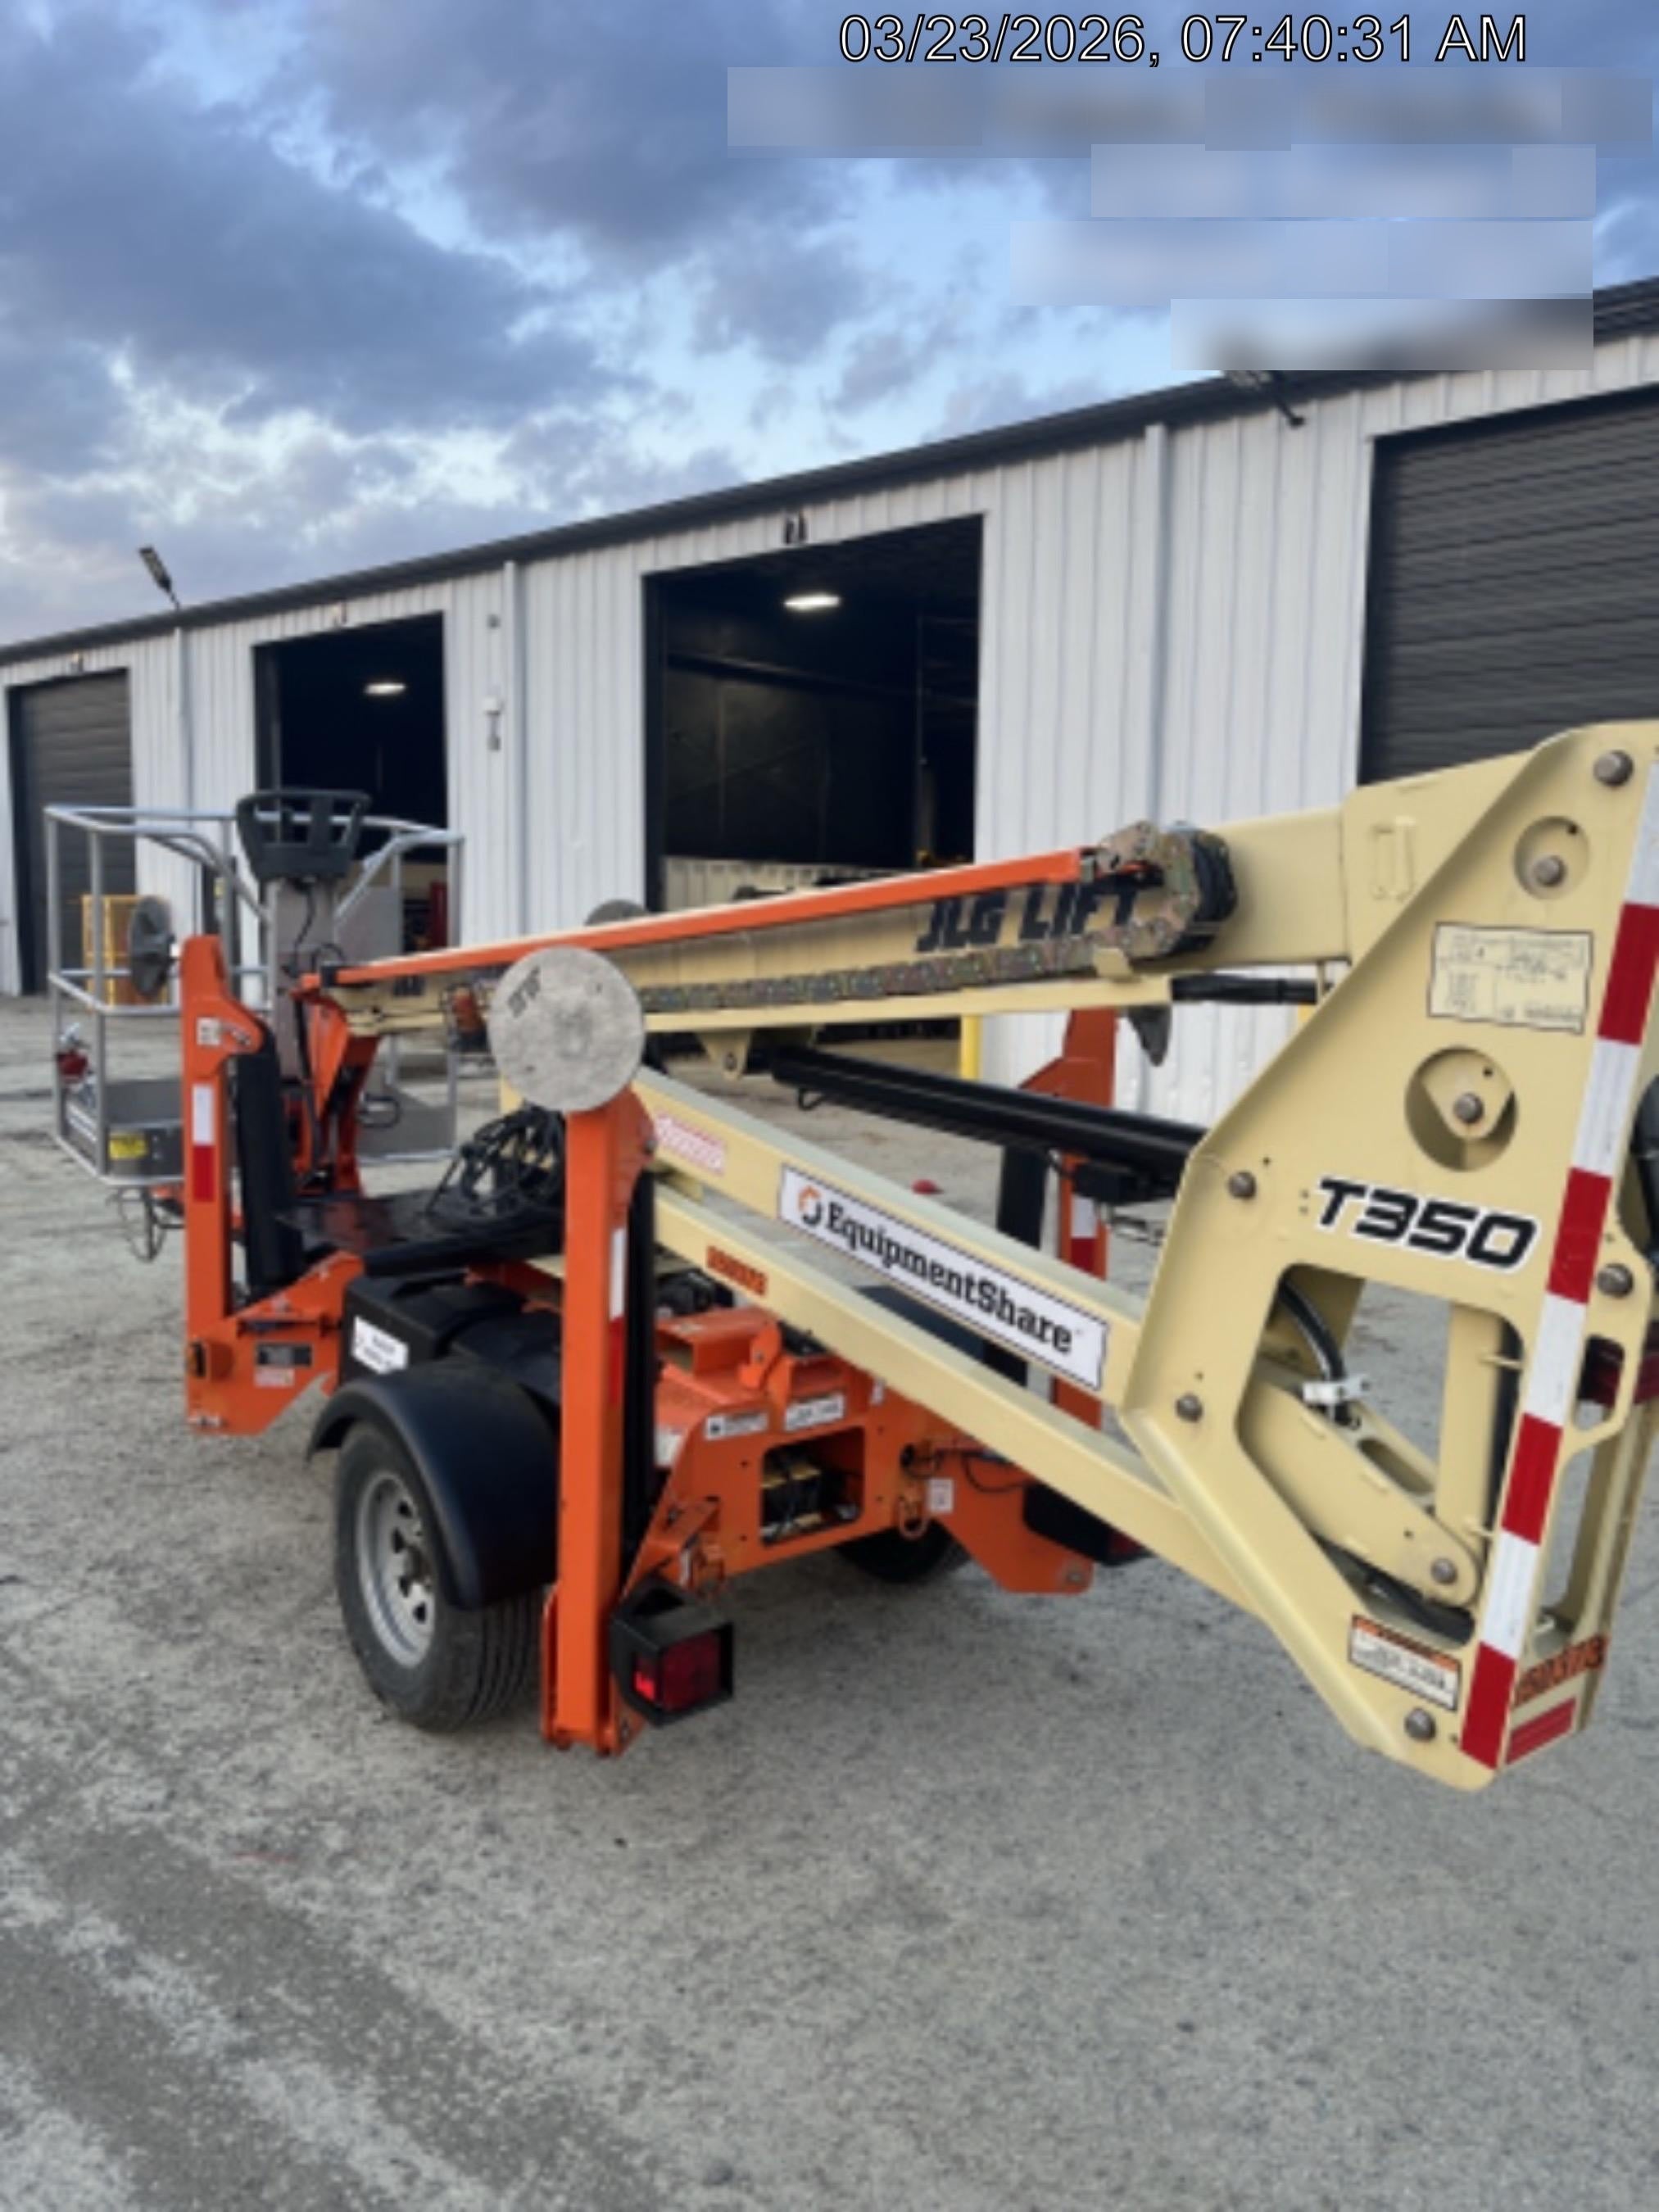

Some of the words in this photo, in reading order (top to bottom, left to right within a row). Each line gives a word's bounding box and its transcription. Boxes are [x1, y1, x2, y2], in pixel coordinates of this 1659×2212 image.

[917, 888, 1009, 952] JLG
[1321, 1179, 1535, 1267] T350
[827, 1201, 1072, 1353] EquipmentShare
